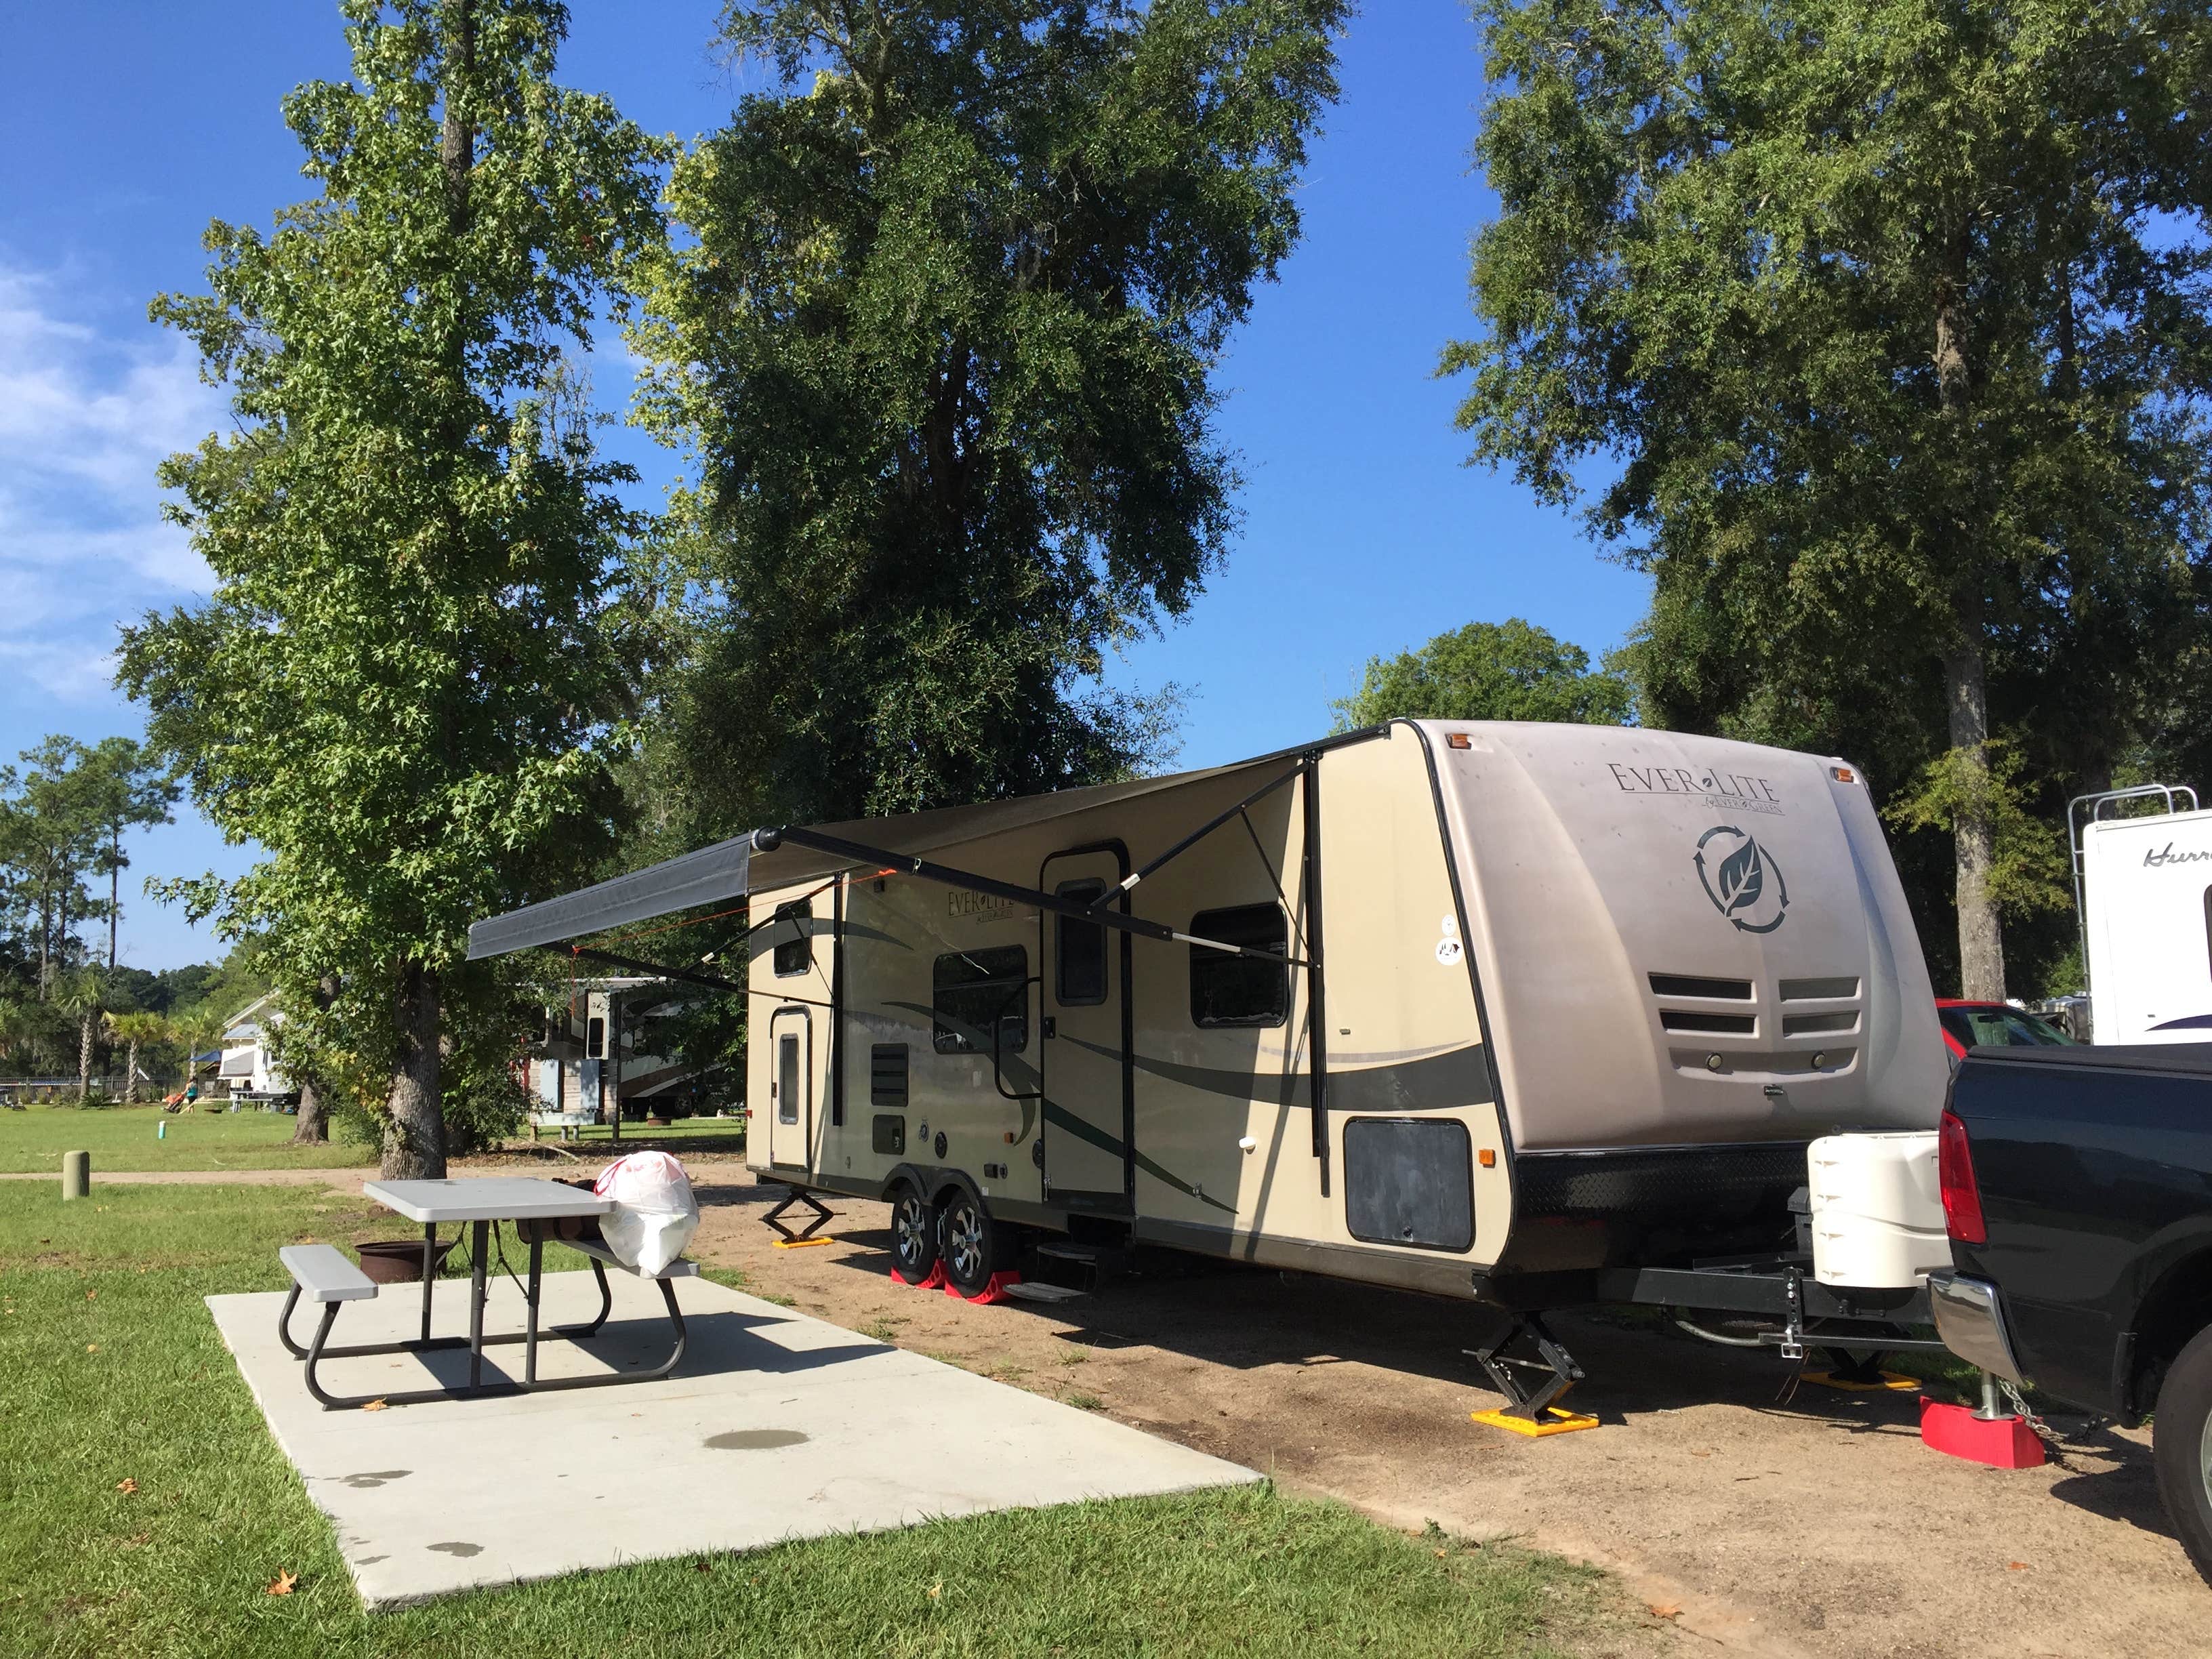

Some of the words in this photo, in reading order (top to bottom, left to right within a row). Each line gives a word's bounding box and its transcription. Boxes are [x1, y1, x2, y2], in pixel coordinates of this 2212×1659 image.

[1605, 763, 1708, 792] EVER
[1706, 768, 1780, 802] LITE
[2143, 842, 2212, 867] Hurr
